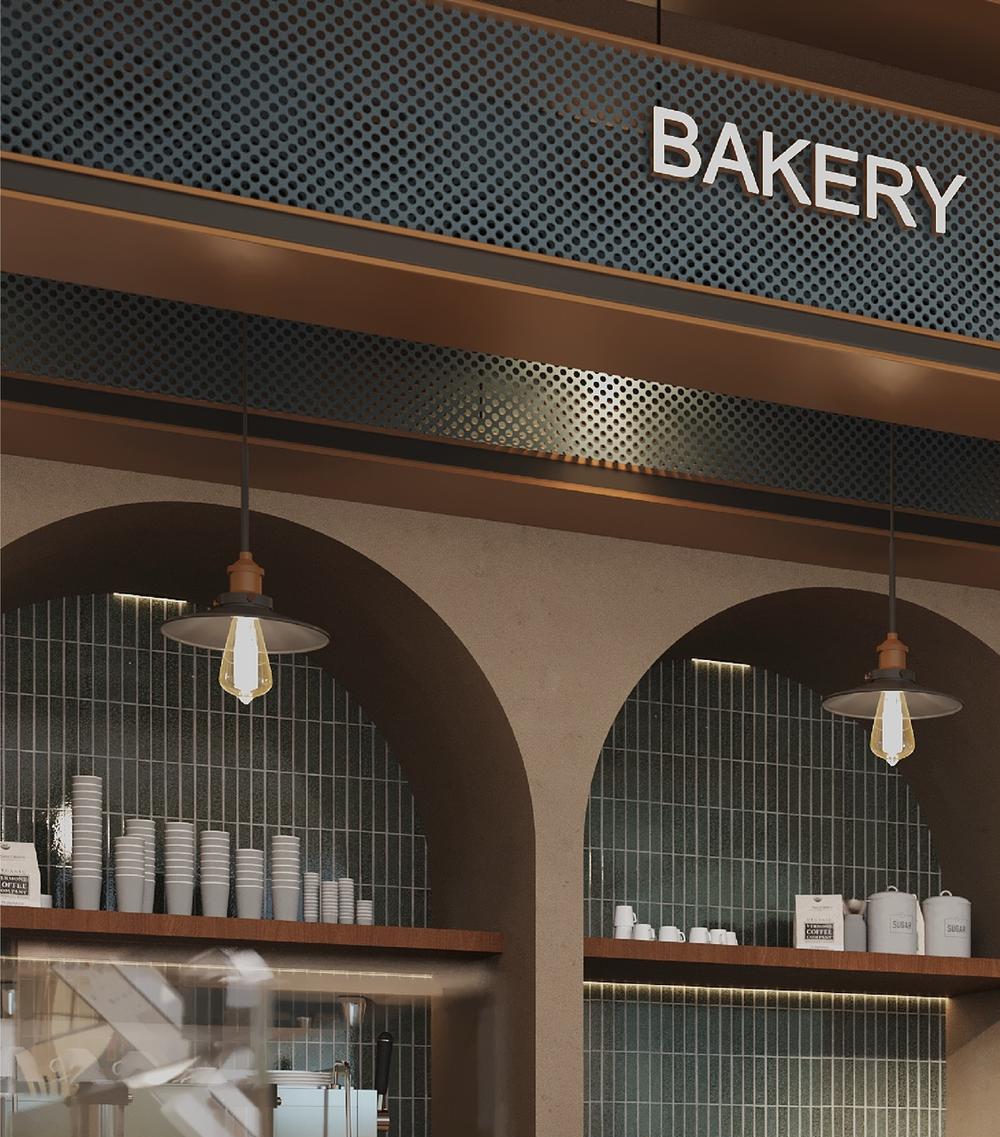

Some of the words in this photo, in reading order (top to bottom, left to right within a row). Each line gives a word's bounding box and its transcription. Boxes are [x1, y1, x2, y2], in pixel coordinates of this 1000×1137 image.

[653, 105, 967, 234] BAKERY
[1, 881, 27, 889] OFFEE
[892, 920, 912, 929] SUGAR
[947, 924, 966, 933] SUGAR
